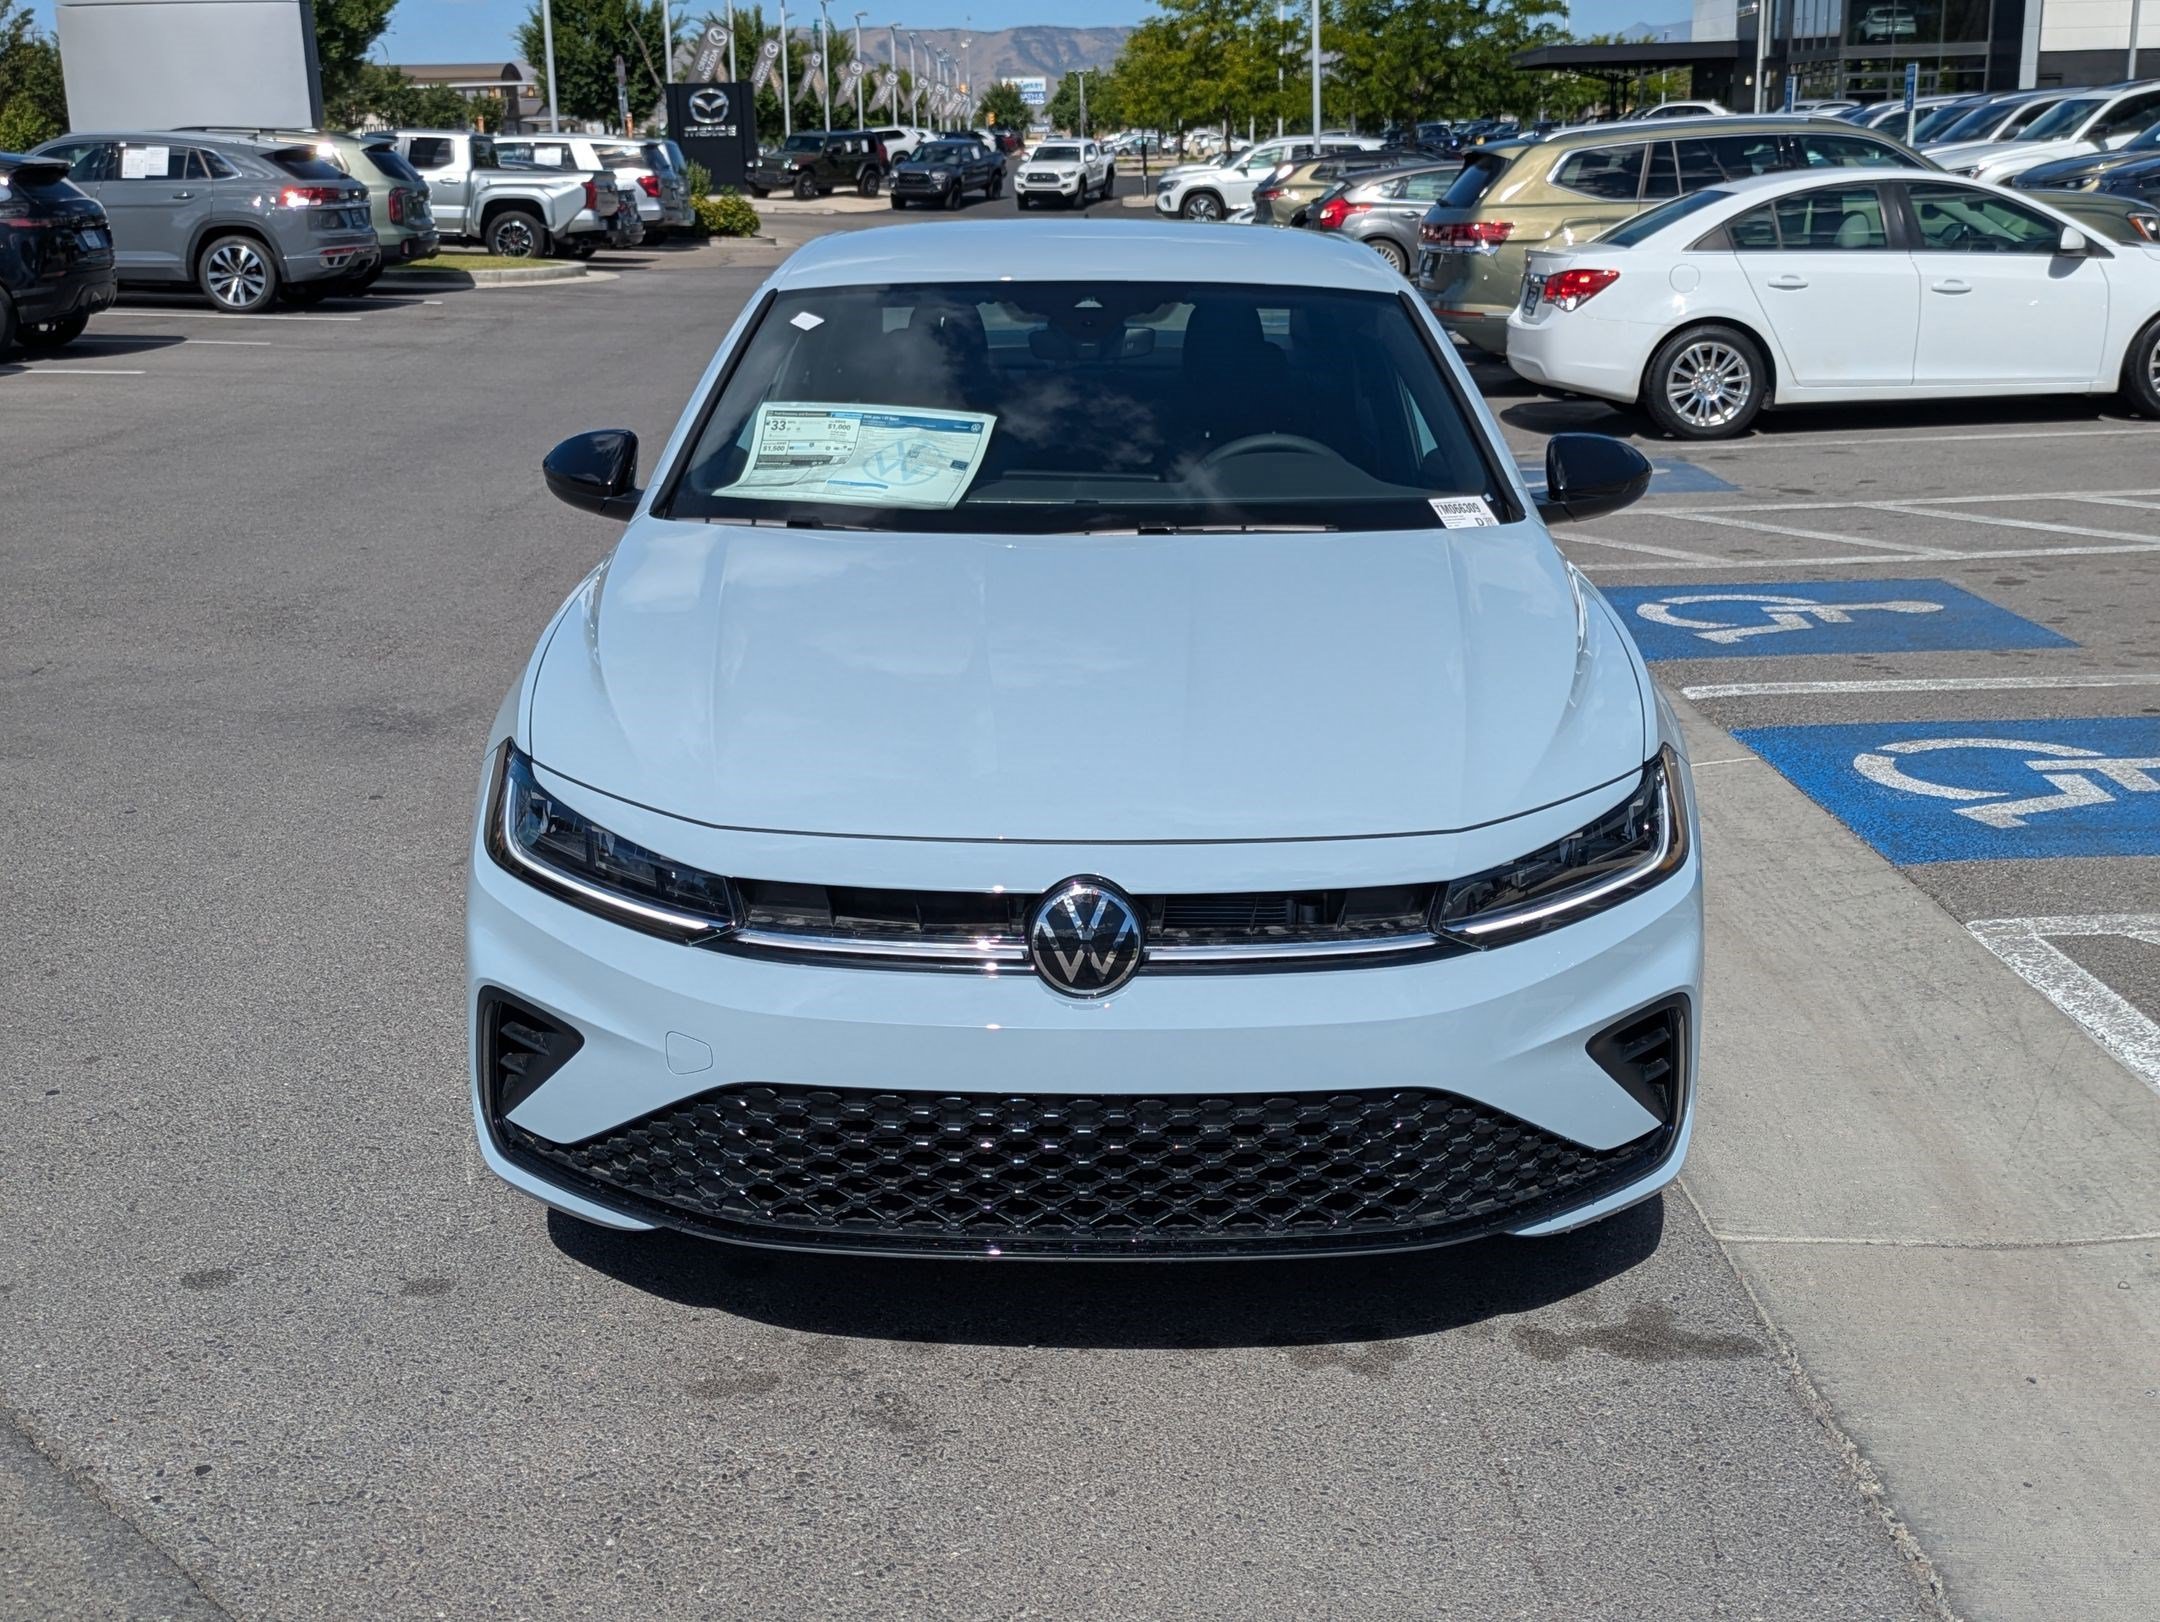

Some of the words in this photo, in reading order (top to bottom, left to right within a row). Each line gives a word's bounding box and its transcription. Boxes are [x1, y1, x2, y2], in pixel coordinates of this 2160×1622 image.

[702, 49, 720, 81] MAZDA
[771, 420, 786, 431] 33
[827, 423, 851, 431] $1,000
[1435, 503, 1481, 515] TM066309
